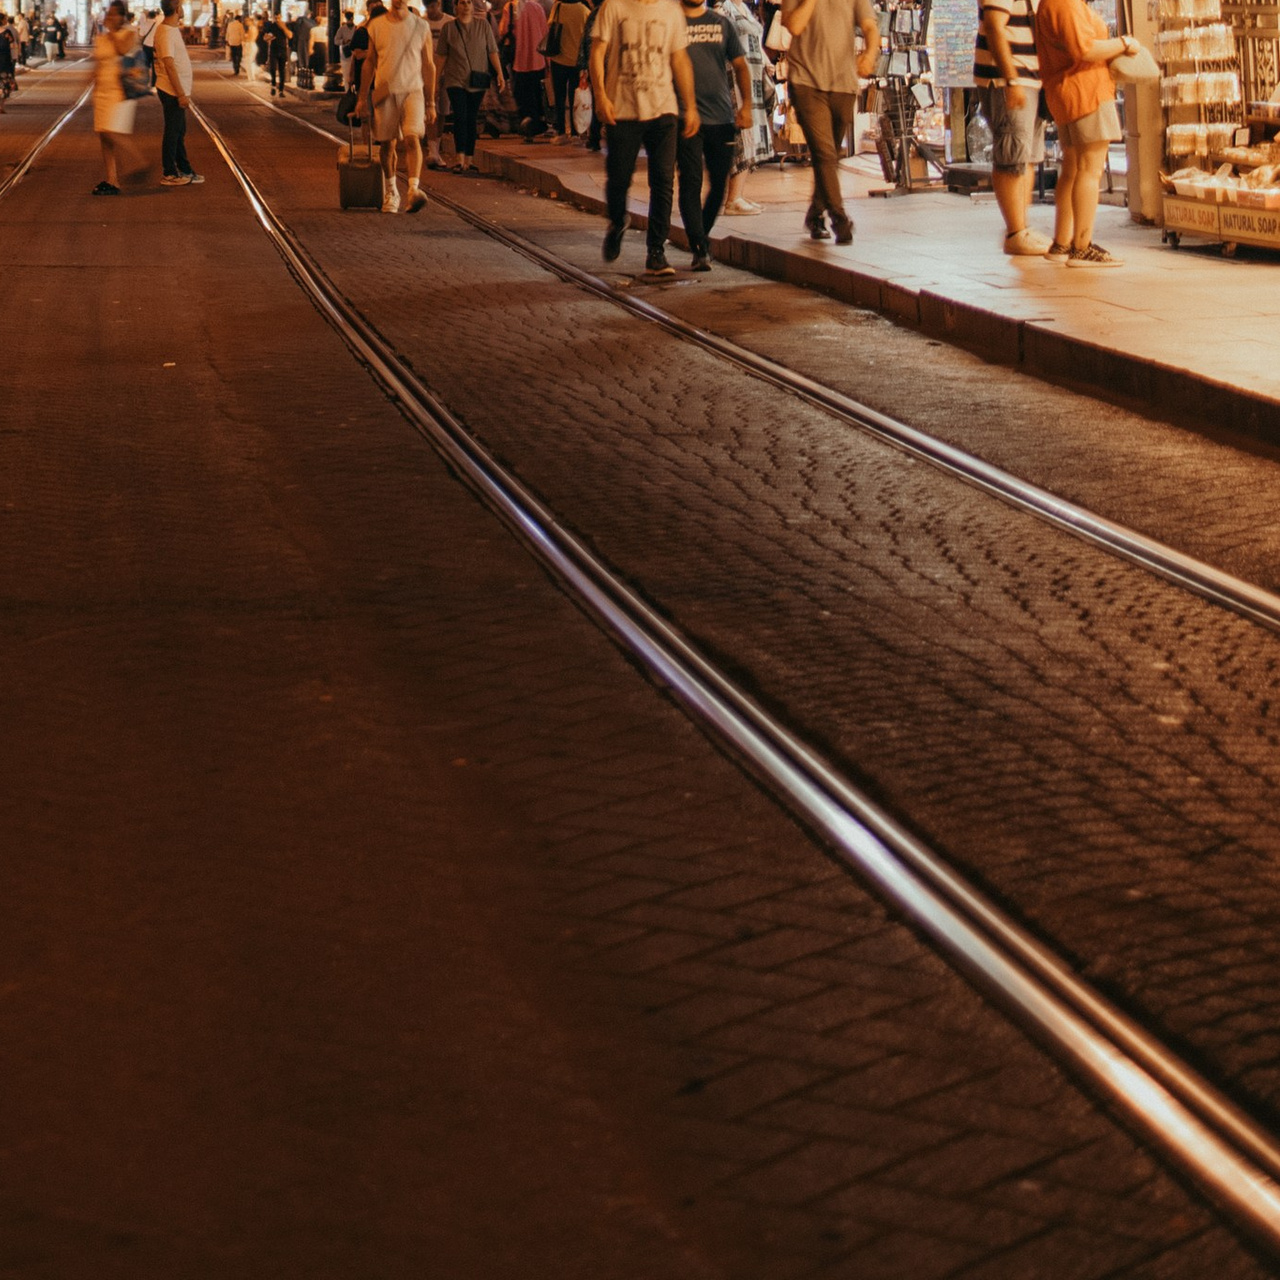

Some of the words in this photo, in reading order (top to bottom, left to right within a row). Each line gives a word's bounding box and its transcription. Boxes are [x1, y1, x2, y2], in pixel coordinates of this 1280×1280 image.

[689, 33, 723, 43] MOUR
[1197, 209, 1215, 226] SOAP
[1223, 213, 1256, 232] NATURAL
[1257, 217, 1277, 234] SOAP
